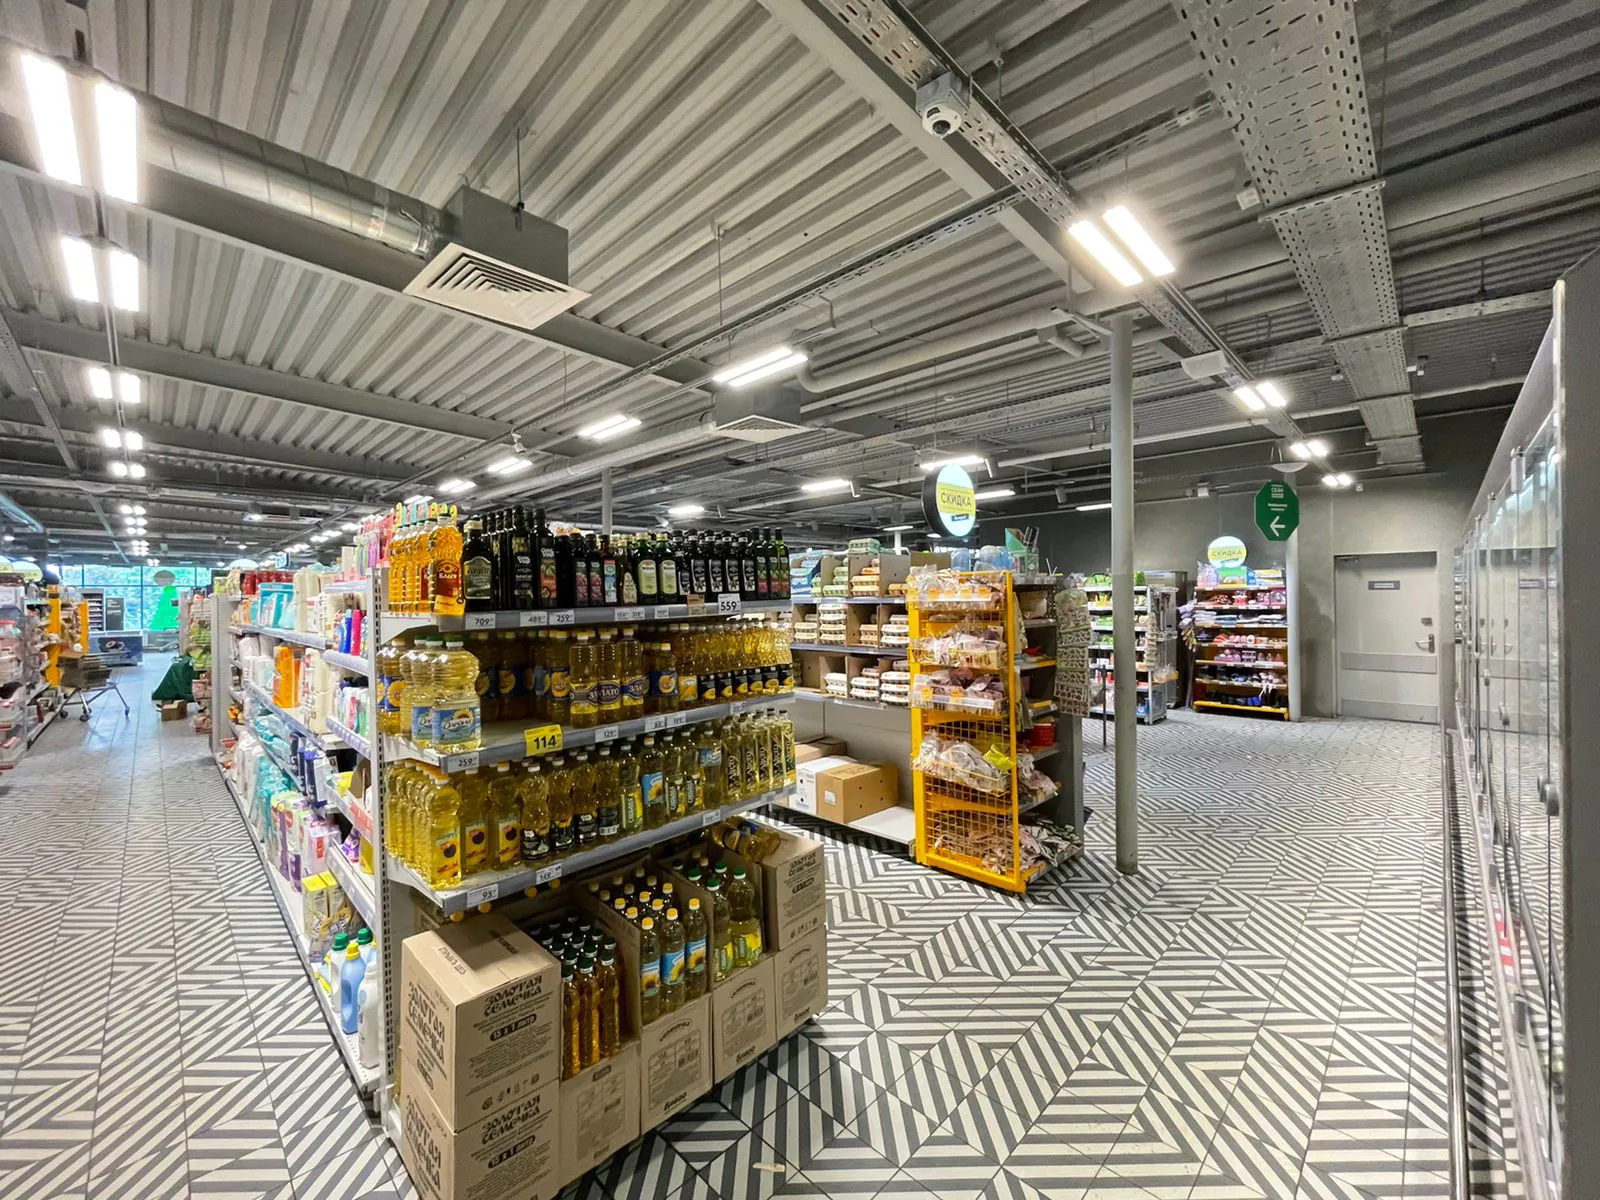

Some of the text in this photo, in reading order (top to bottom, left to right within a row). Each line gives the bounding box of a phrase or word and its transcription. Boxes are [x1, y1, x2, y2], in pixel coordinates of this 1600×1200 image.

[940, 491, 973, 507] СКИДКА
[556, 614, 570, 622] 259
[720, 600, 737, 612] 559
[475, 617, 490, 626] 709
[534, 735, 556, 750] 114
[459, 758, 473, 767] 259
[482, 891, 493, 900] 95
[484, 986, 542, 1017] СЕМЕЧКА
[485, 975, 543, 1004] ЗОЛОТАЯ
[408, 981, 445, 1043] ЗОЛОТАЯ
[408, 1000, 445, 1064] СЕМЕЧКА
[482, 1094, 541, 1133] ЗОЛОТАЯ
[482, 1107, 541, 1145] СЕМЕЧКА
[406, 1095, 442, 1169] ЗОЛОТАЯ
[405, 1112, 441, 1192] СЕМЕЧКА
